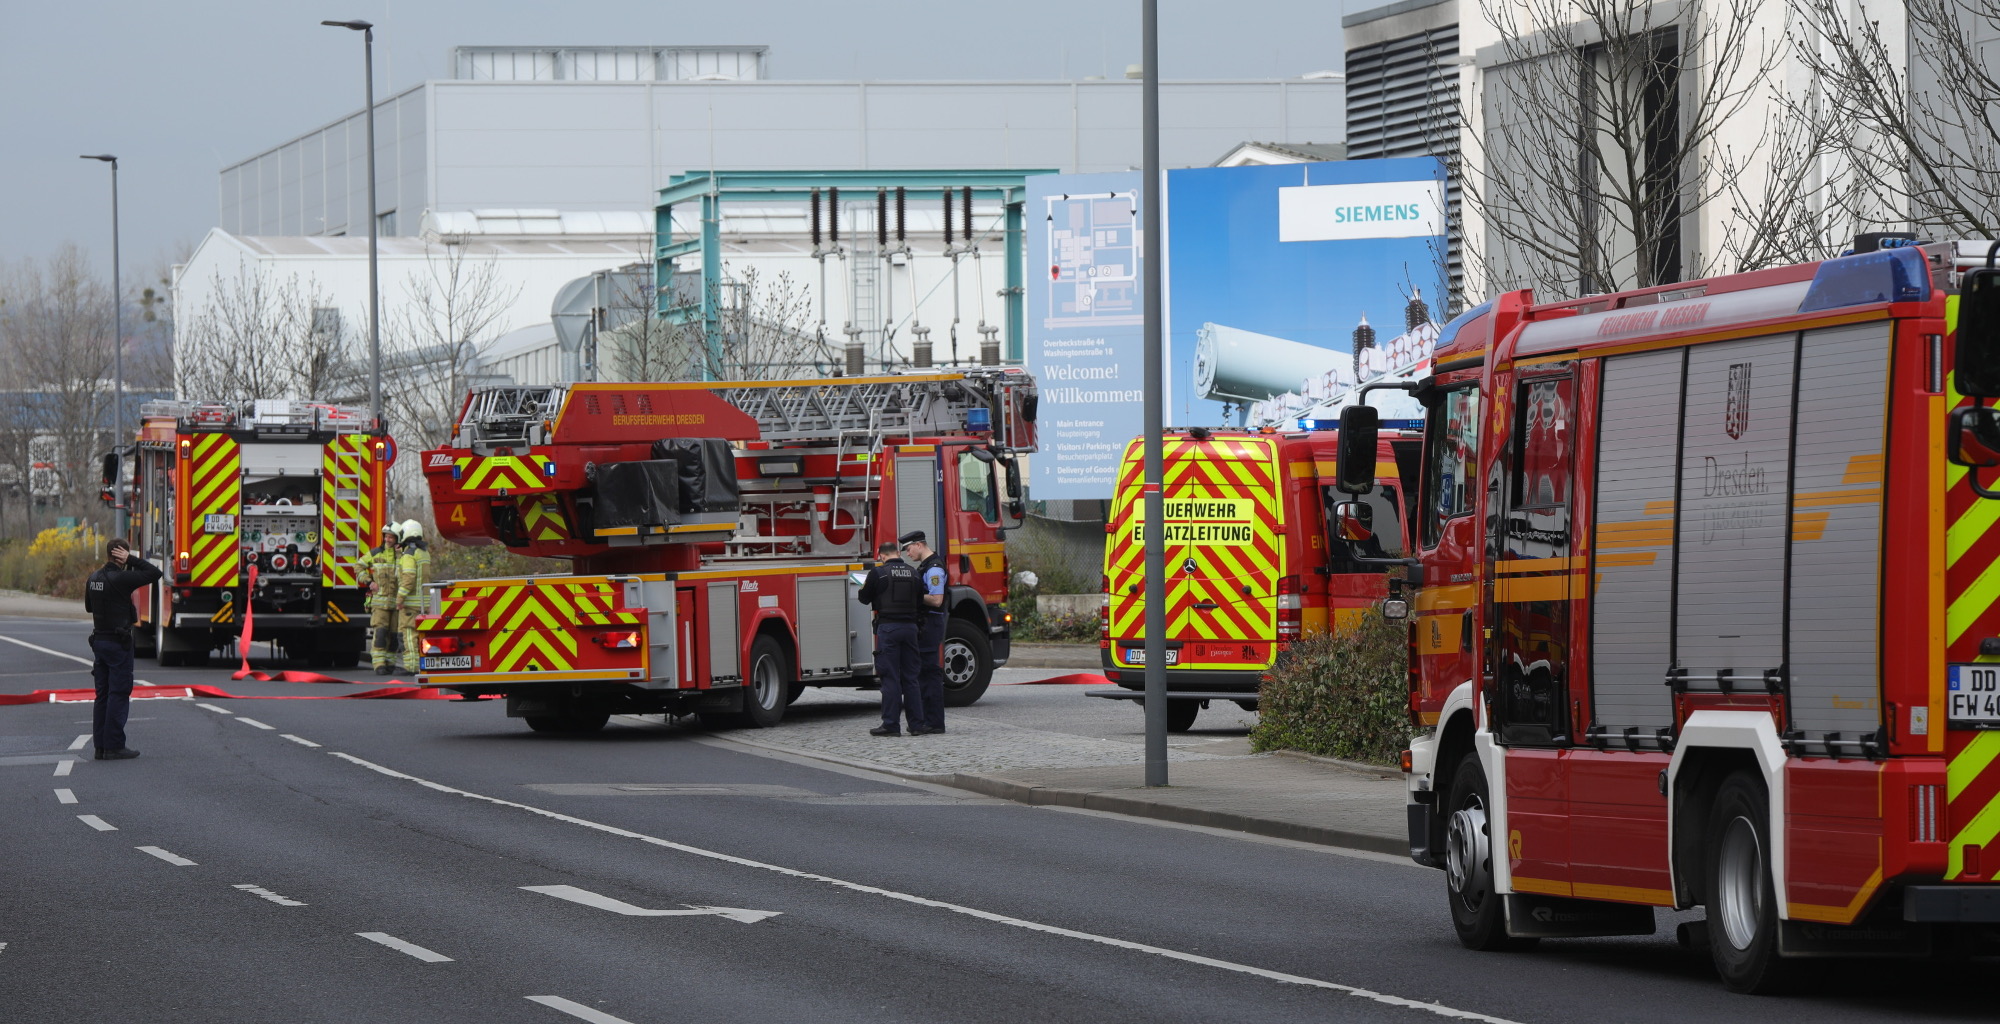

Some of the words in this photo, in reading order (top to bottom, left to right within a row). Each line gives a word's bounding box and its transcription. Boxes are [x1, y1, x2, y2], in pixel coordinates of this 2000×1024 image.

[1335, 203, 1420, 223] SIEMENS
[1597, 310, 1659, 336] FEUERWEHR
[1661, 302, 1711, 327] DRESDEN
[1043, 338, 1095, 348] Overbeckstraße
[1096, 338, 1105, 346] 44
[1043, 348, 1103, 358] Washingtonstraße
[1105, 347, 1113, 356] 18
[1044, 363, 1119, 381] Welcome!
[1044, 387, 1143, 404] Willkommen
[1493, 386, 1506, 434] 5
[613, 414, 675, 426] BERUFSFEUERWEHR
[676, 414, 705, 425] DRESDEN
[1056, 420, 1074, 428] Main
[1075, 420, 1104, 428] Entrance
[1056, 430, 1101, 439] Haupteingang
[1086, 443, 1111, 451] Parking
[1112, 442, 1121, 450] lot
[429, 454, 453, 467] Me
[1057, 453, 1113, 462] Besucherparkplatz
[886, 458, 894, 481] 4
[1057, 466, 1084, 475] Delivery
[1095, 465, 1115, 474] Goods
[1057, 476, 1112, 484] Warenanlieferung
[451, 504, 467, 526] 4
[1163, 503, 1236, 518] UERWEHR
[206, 523, 215, 531] FW
[216, 523, 232, 531] 4094
[1134, 526, 1251, 541] EIATZLEITUNG
[891, 569, 912, 577] POLIZEI
[740, 580, 759, 592] Metz
[1131, 651, 1141, 660] DD
[425, 658, 435, 668] DD
[440, 658, 450, 667] FW
[451, 657, 470, 667] 4064
[1971, 670, 1996, 691] DD
[1953, 694, 1978, 716] FW
